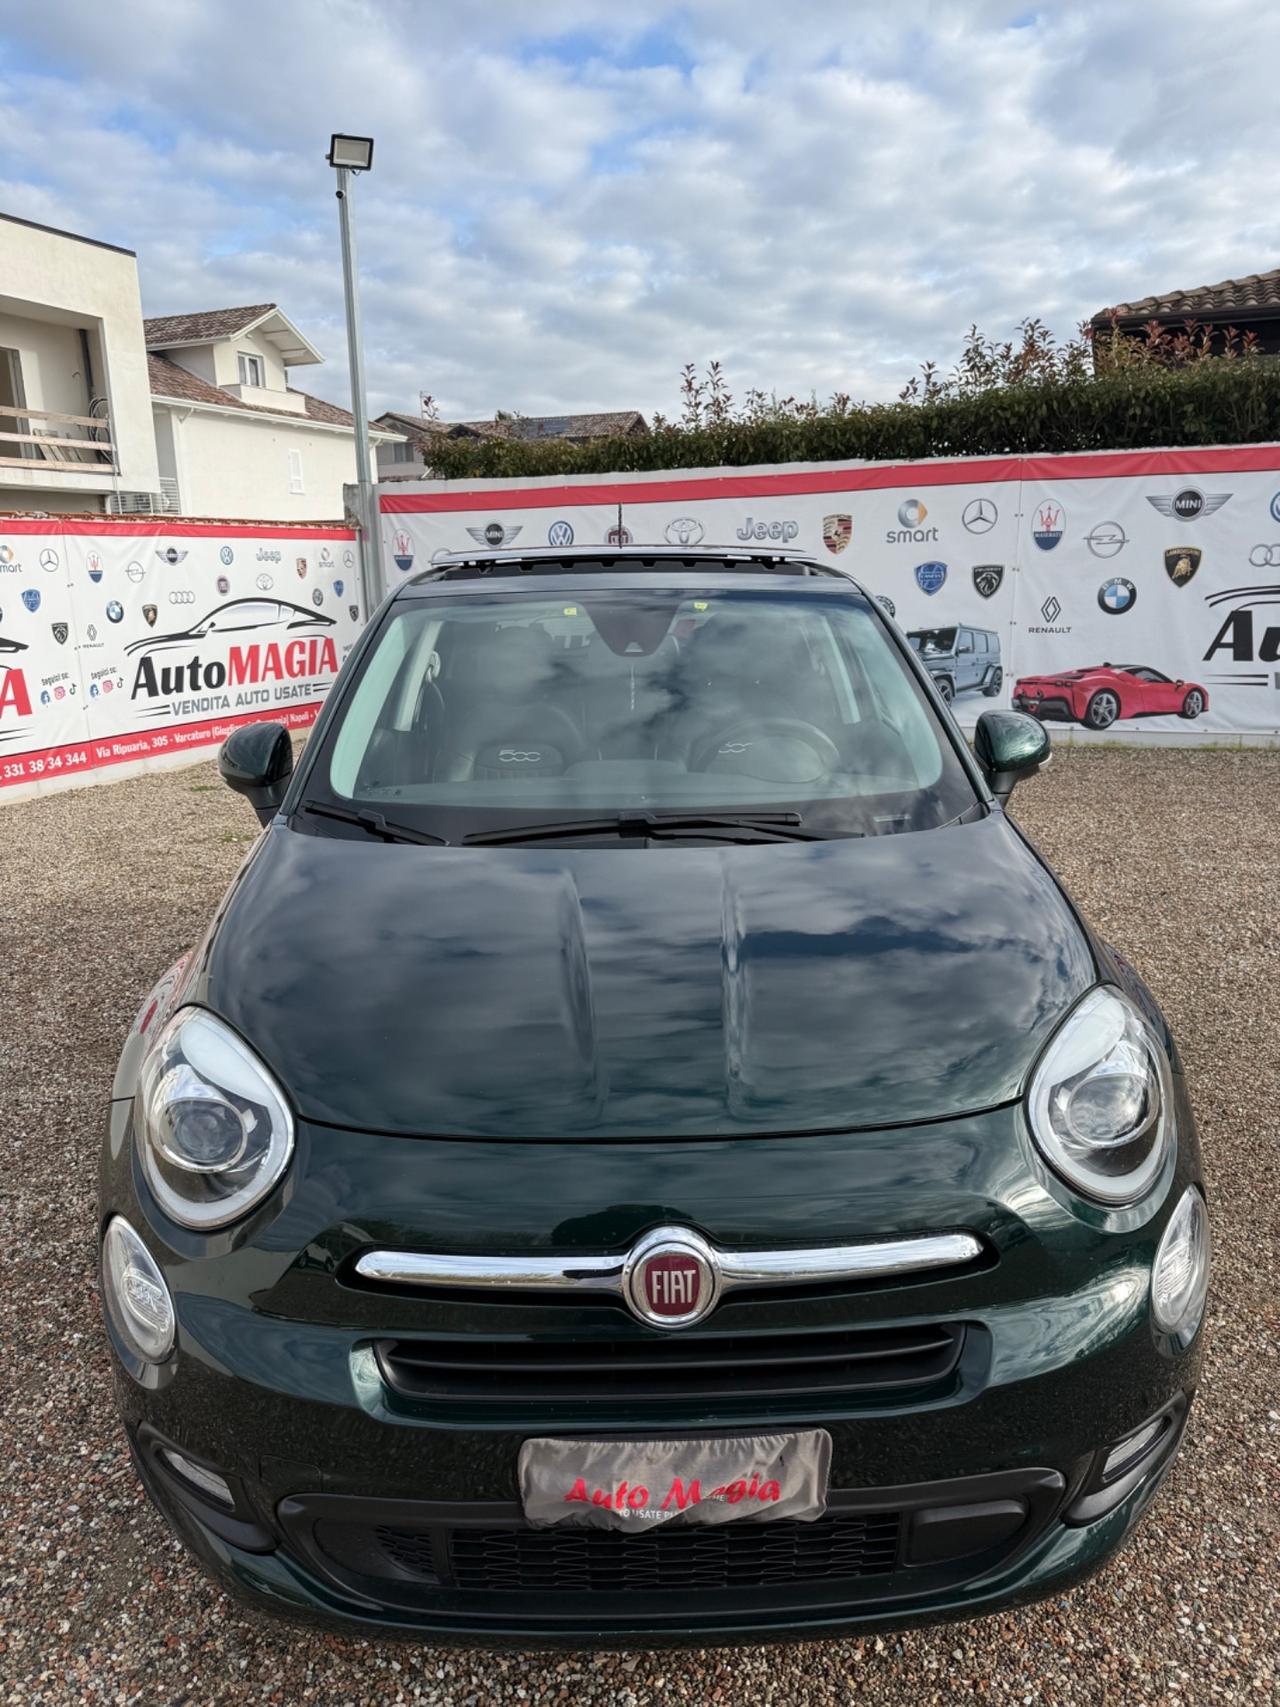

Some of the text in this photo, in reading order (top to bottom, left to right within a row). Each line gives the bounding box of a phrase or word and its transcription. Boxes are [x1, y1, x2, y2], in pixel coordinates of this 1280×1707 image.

[1176, 499, 1200, 509] MINI
[737, 518, 799, 542] Jeep
[886, 528, 939, 543] smart
[256, 548, 282, 564] Jeep
[131, 638, 338, 700] AutoMAGIA
[172, 684, 312, 716] VENDITA AUTO USATE
[96, 747, 111, 758] Via
[112, 740, 151, 755] Ripuaria,
[152, 735, 168, 748] 305
[174, 729, 211, 743] Varcaturo
[3, 751, 87, 778] 331 38 34 344
[651, 1269, 697, 1305] FIAT
[564, 1478, 649, 1511] Auto
